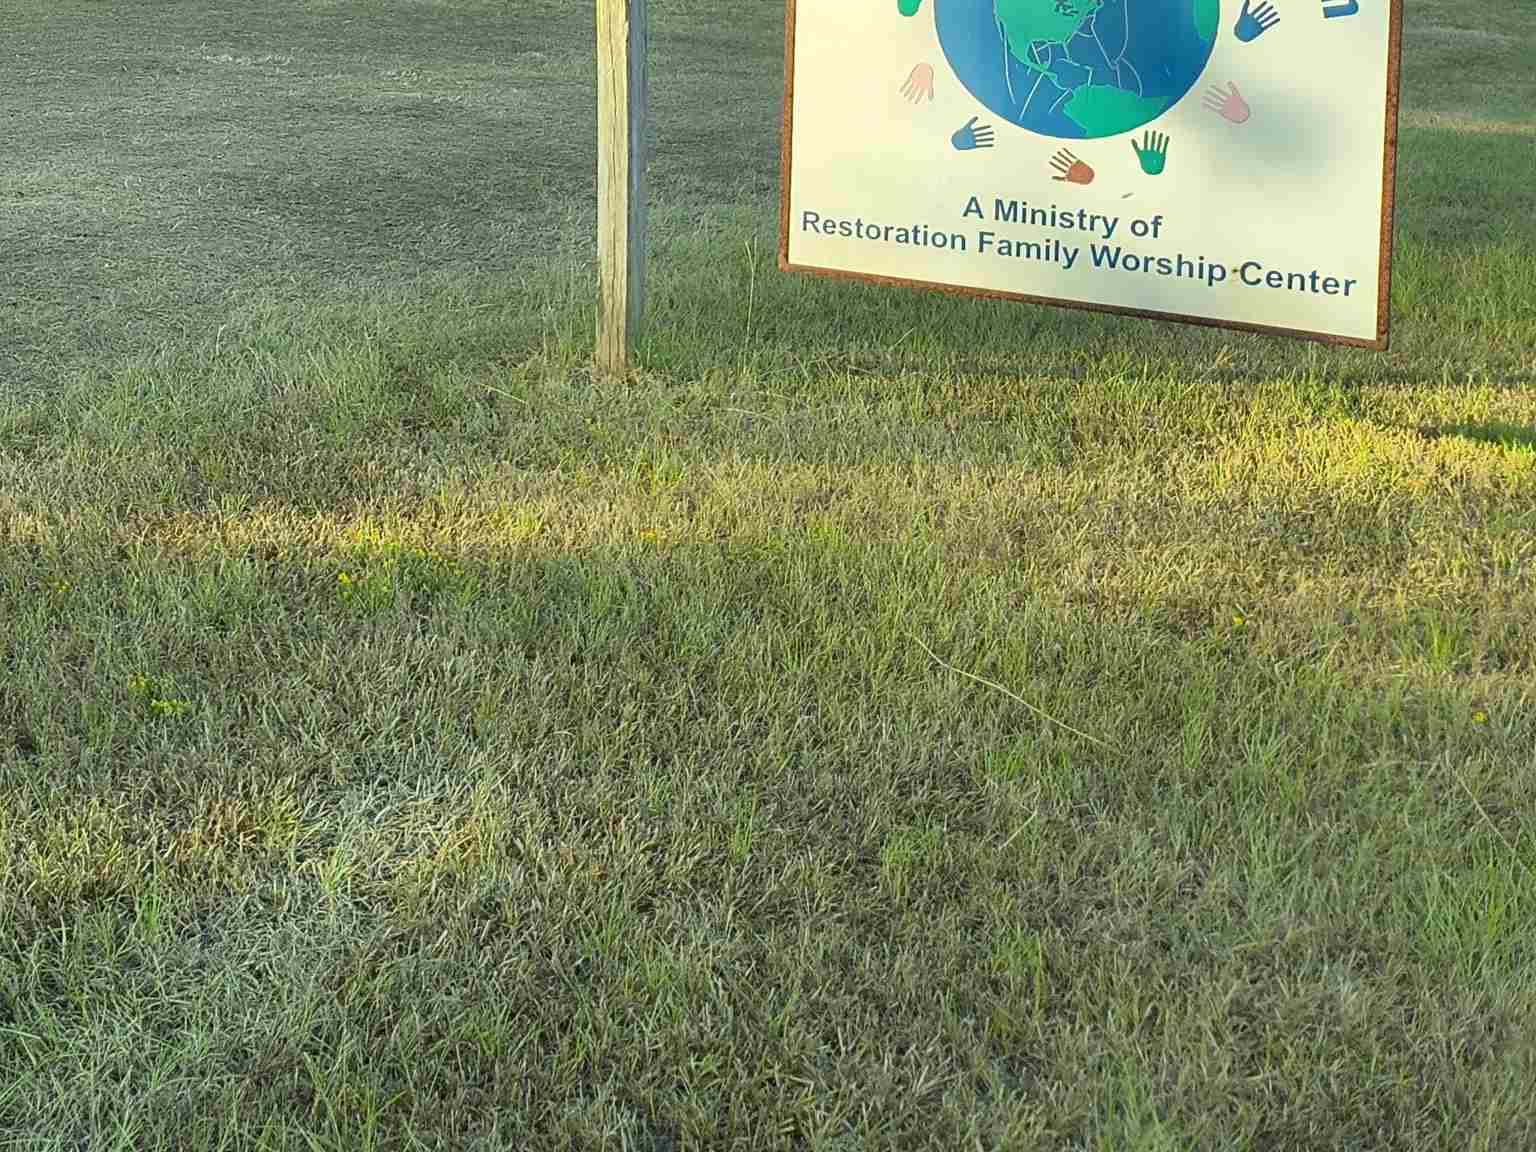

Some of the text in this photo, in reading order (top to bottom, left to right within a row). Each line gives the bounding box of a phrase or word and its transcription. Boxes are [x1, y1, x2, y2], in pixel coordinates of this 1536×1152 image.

[963, 196, 1164, 239] A Ministry of
[802, 212, 1357, 297] Restoration Family Worship Center
